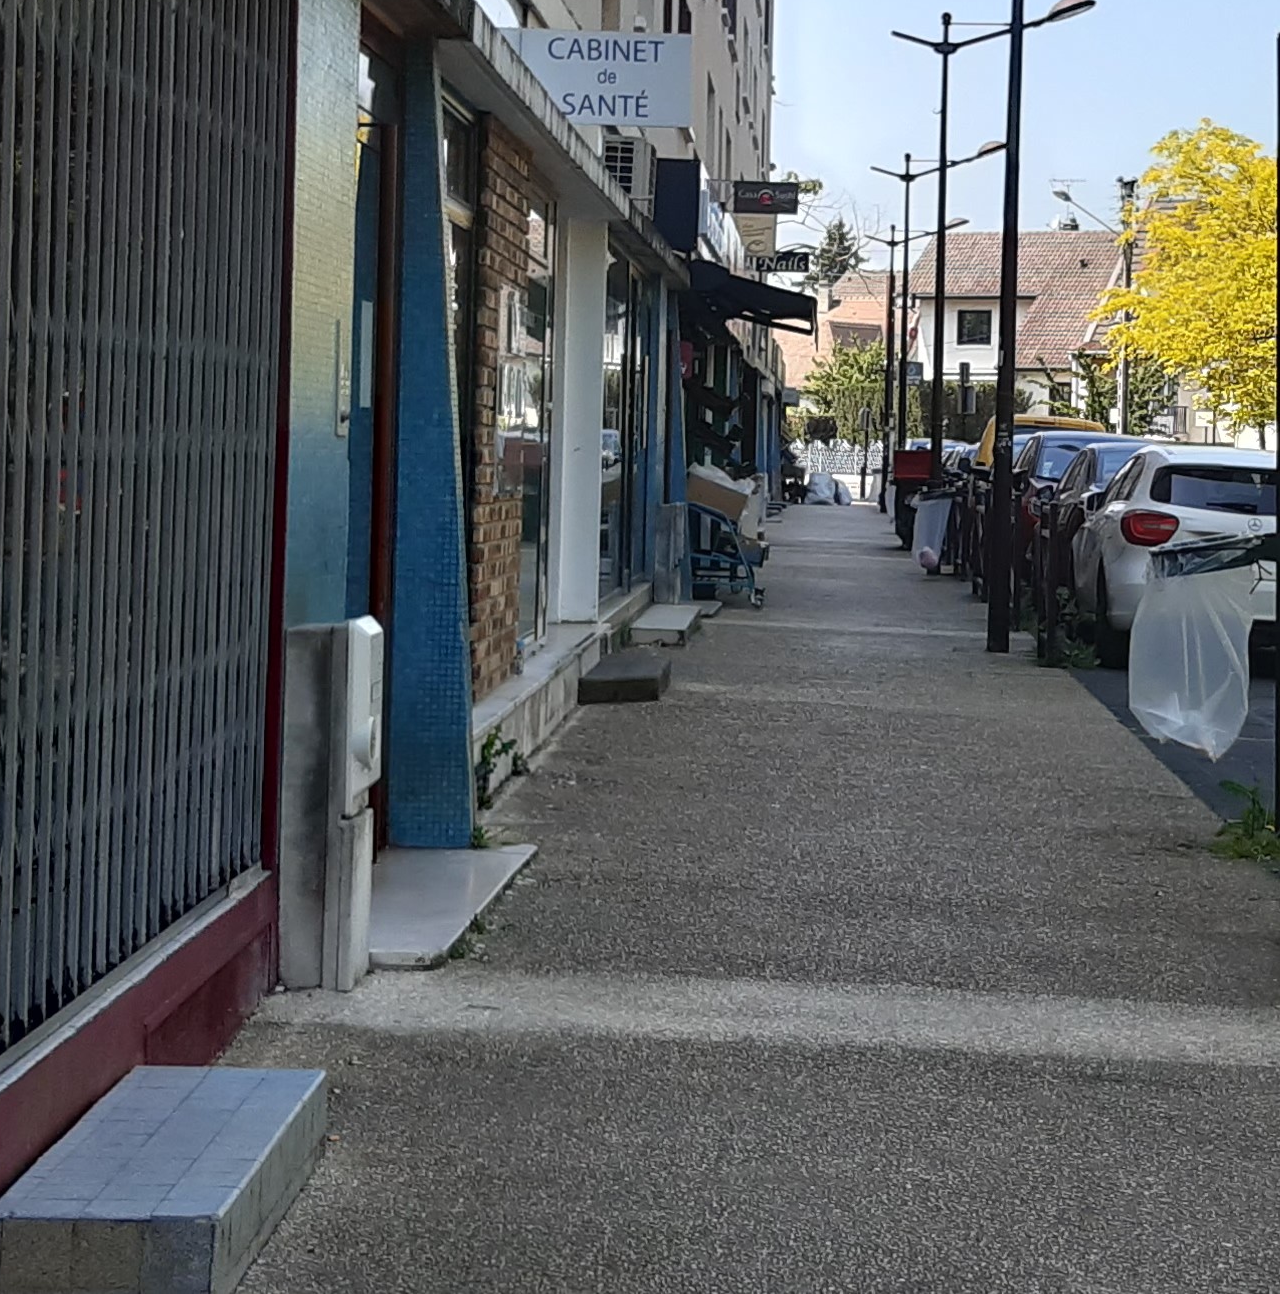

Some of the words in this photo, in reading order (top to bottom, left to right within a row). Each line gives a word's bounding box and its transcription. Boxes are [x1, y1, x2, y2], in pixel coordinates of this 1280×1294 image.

[547, 37, 665, 63] CABINET
[597, 68, 617, 84] de
[562, 89, 649, 118] SANTÉ
[759, 252, 806, 271] Nails
